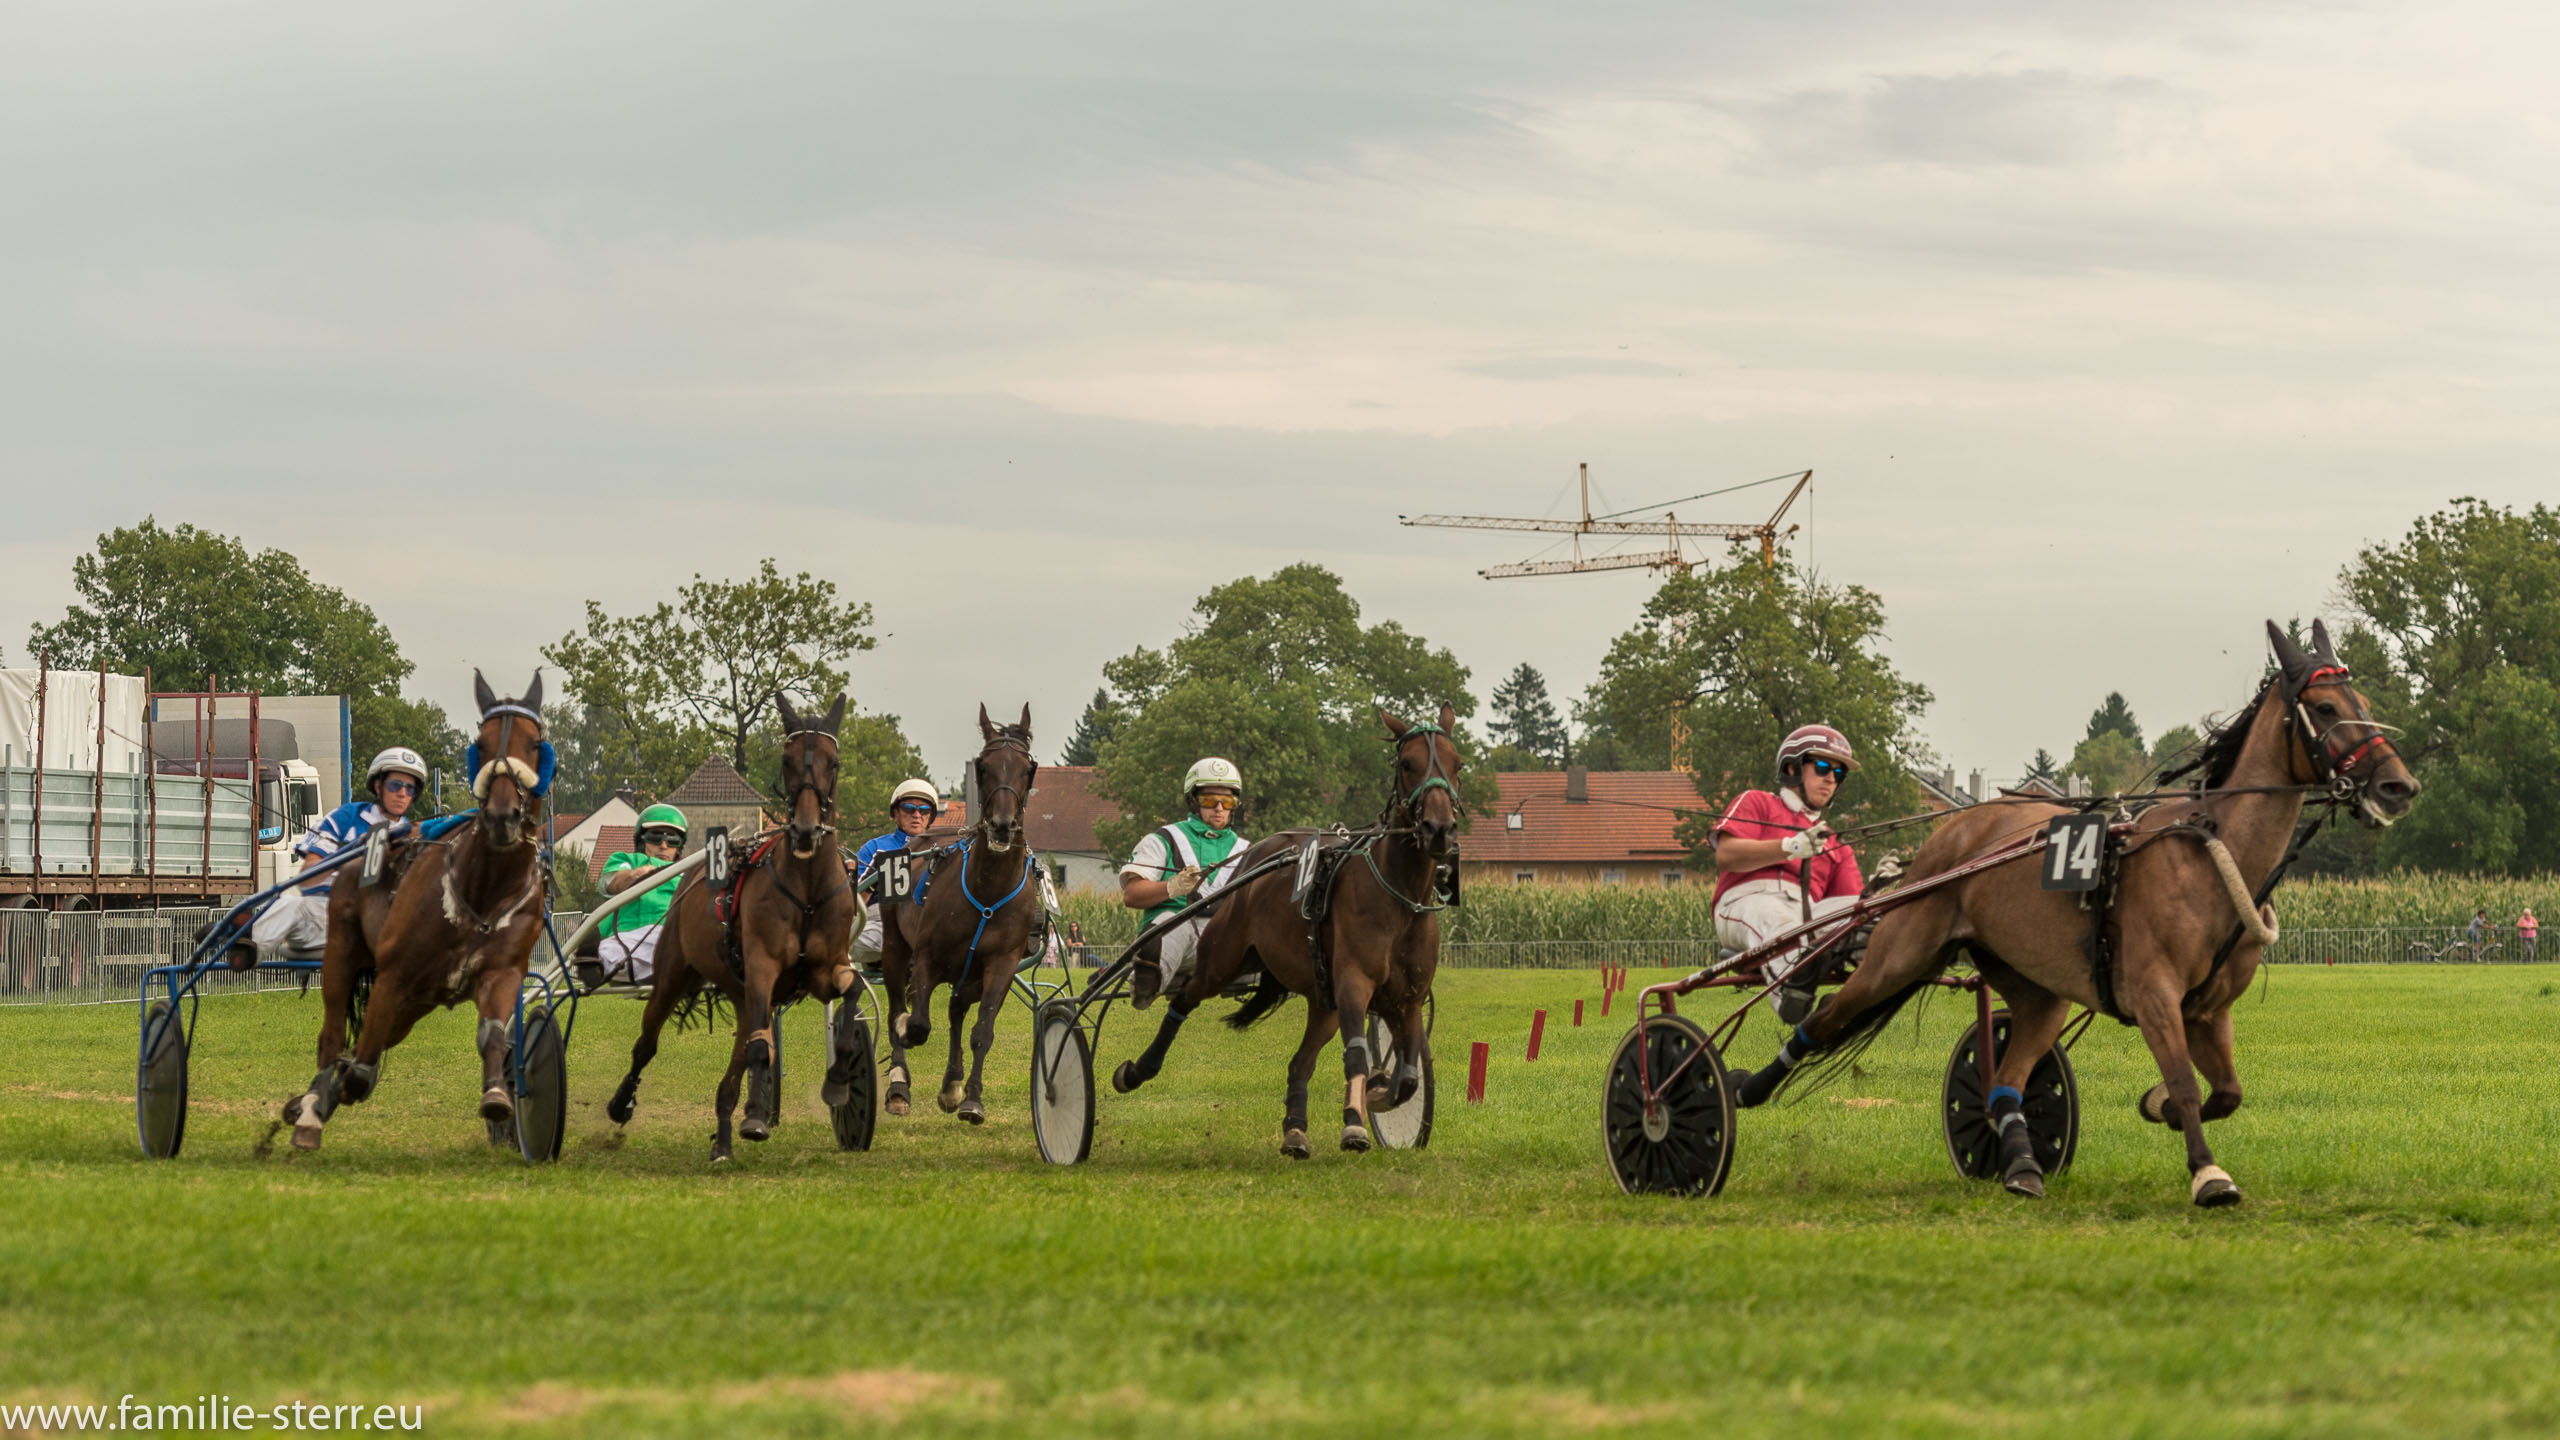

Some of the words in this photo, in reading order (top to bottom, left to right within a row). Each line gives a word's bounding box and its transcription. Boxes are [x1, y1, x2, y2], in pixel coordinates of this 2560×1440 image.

[363, 828, 387, 877] 16
[706, 834, 727, 880] 13
[879, 855, 910, 897] 15
[1297, 840, 1318, 891] 12
[2049, 824, 2099, 880] 14
